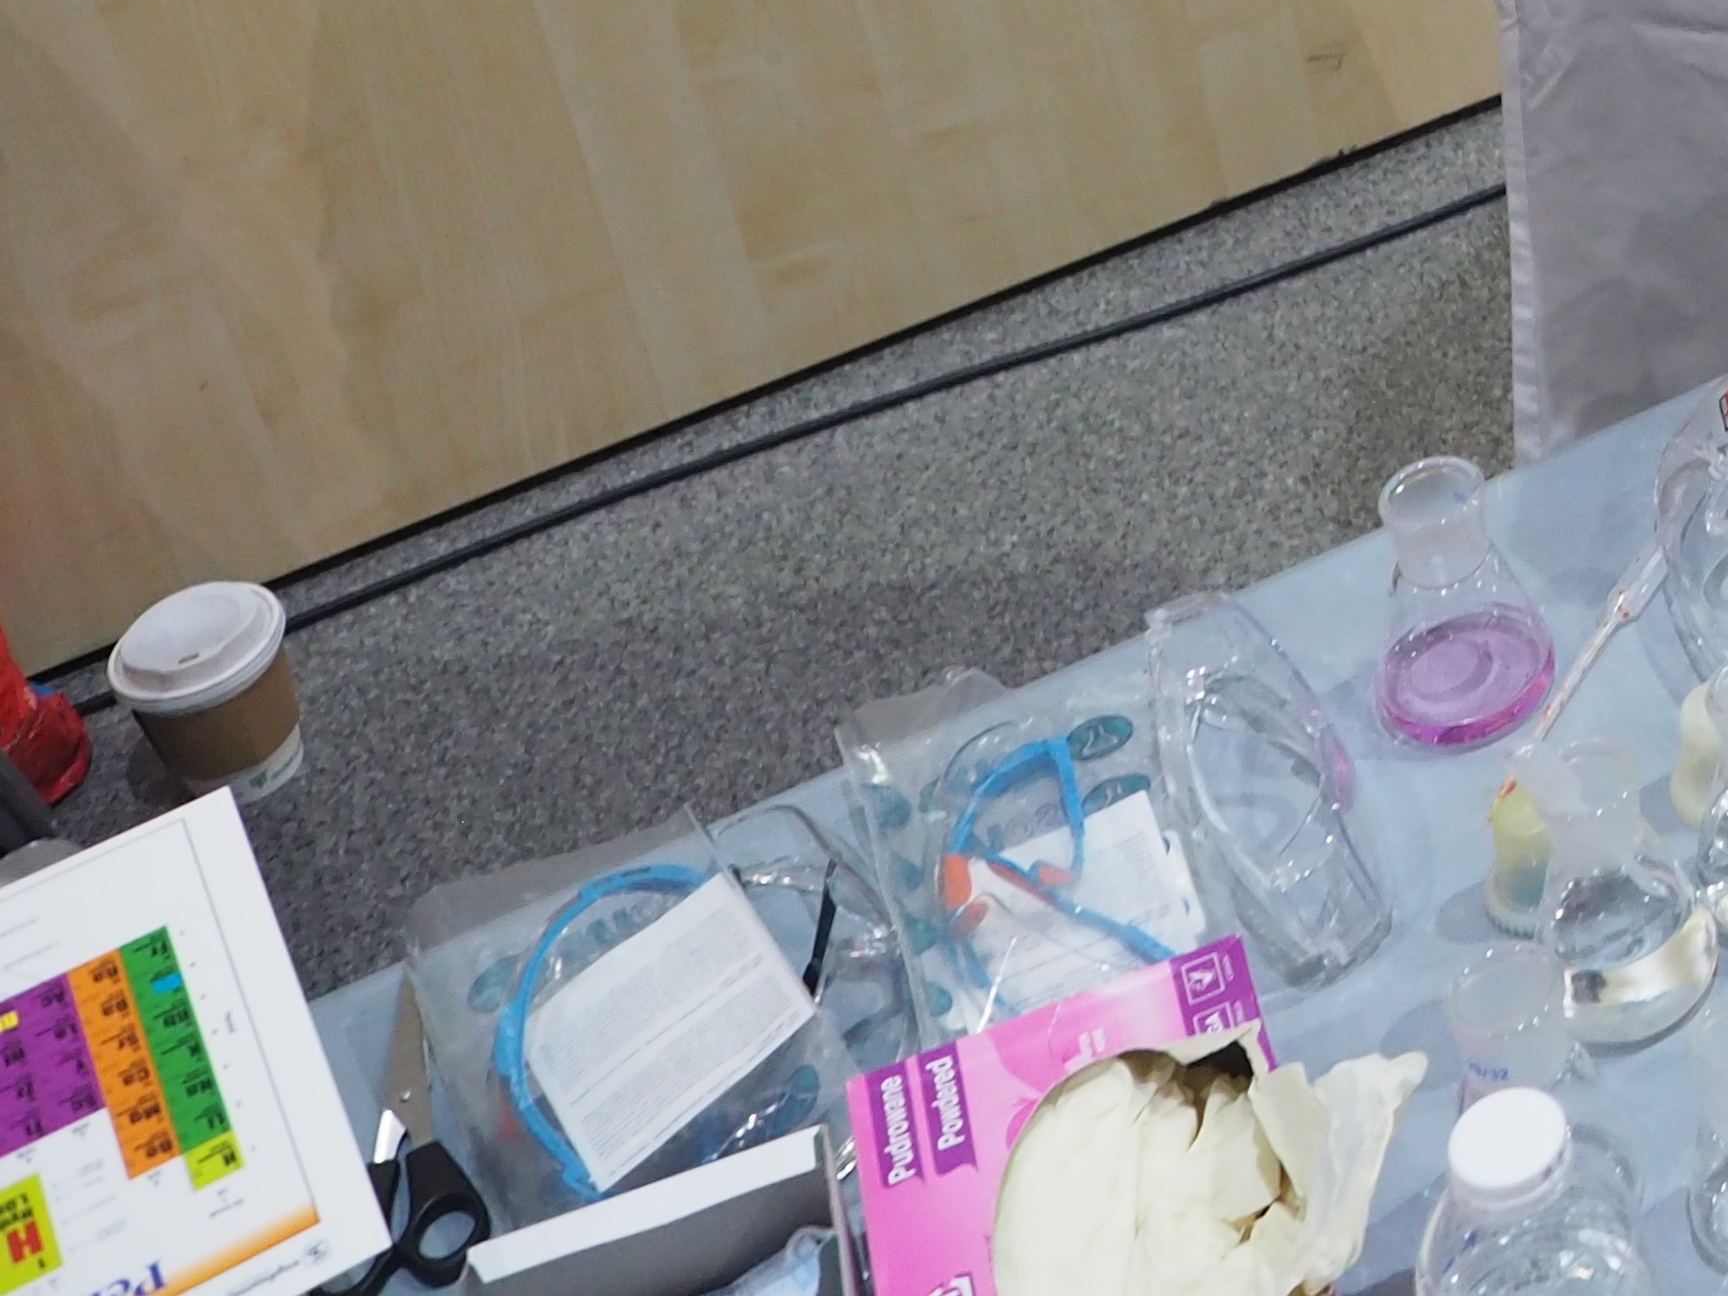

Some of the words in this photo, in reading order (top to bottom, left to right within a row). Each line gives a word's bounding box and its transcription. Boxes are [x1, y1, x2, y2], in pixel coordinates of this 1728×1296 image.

[880, 1074, 916, 1186] Pudrowane
[924, 1054, 966, 1151] Powdered
[6, 1220, 45, 1265] H
